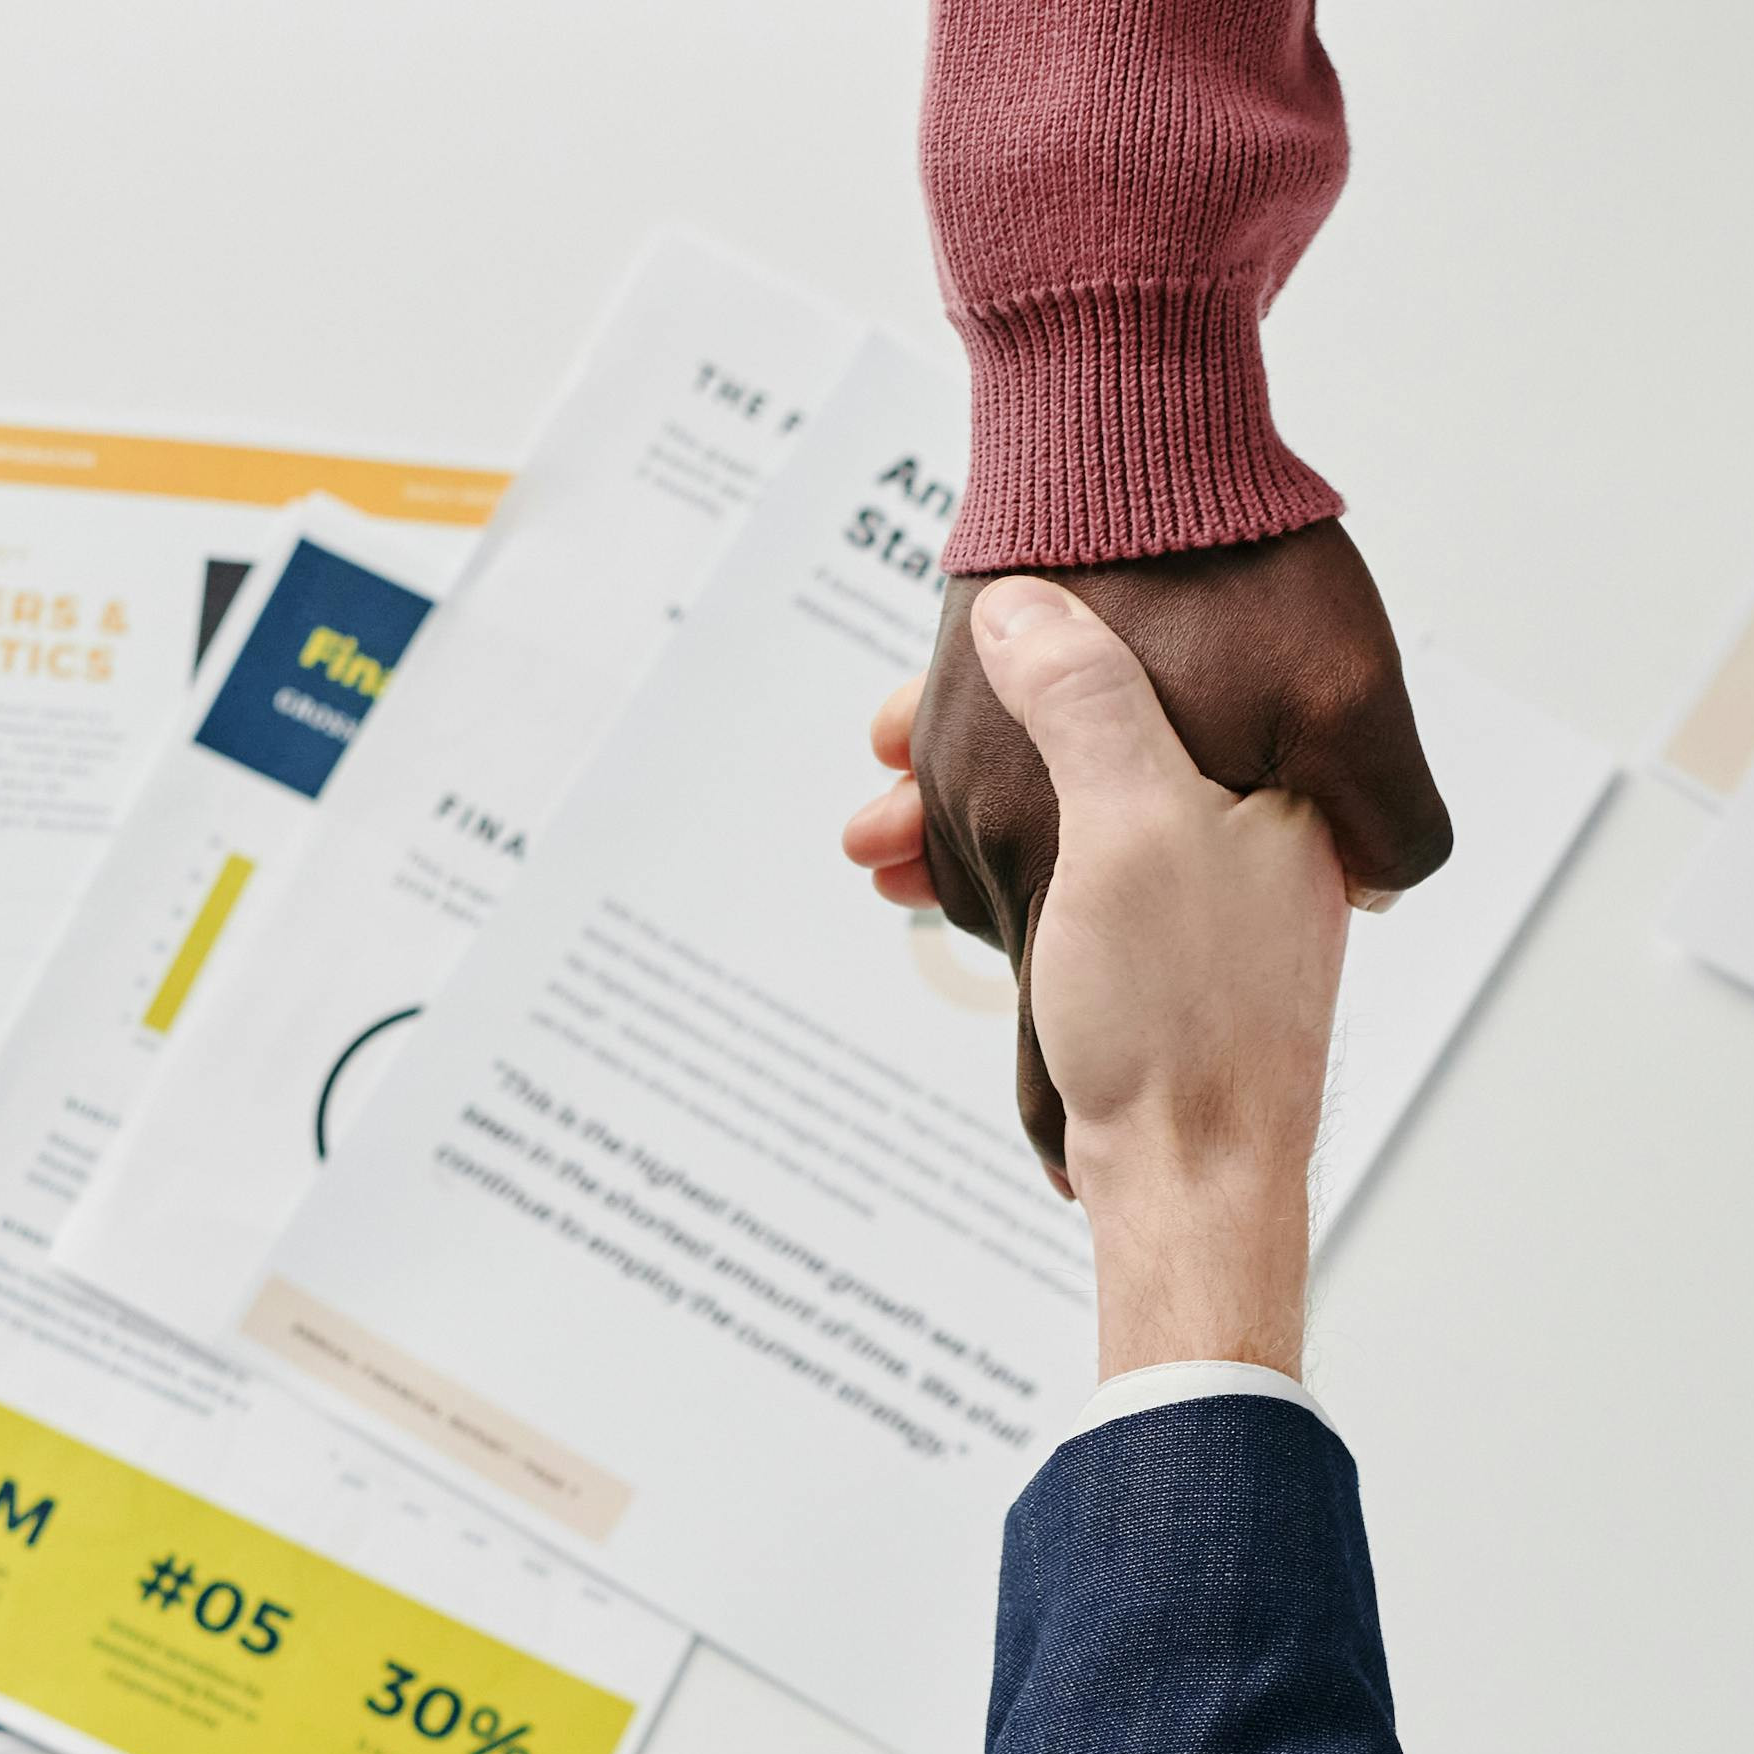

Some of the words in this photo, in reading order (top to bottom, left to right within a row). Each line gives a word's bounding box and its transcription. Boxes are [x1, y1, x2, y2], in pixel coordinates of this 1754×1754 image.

[97, 598, 131, 638] &
[298, 624, 394, 697] Fin
[135, 1552, 297, 1661] #05
